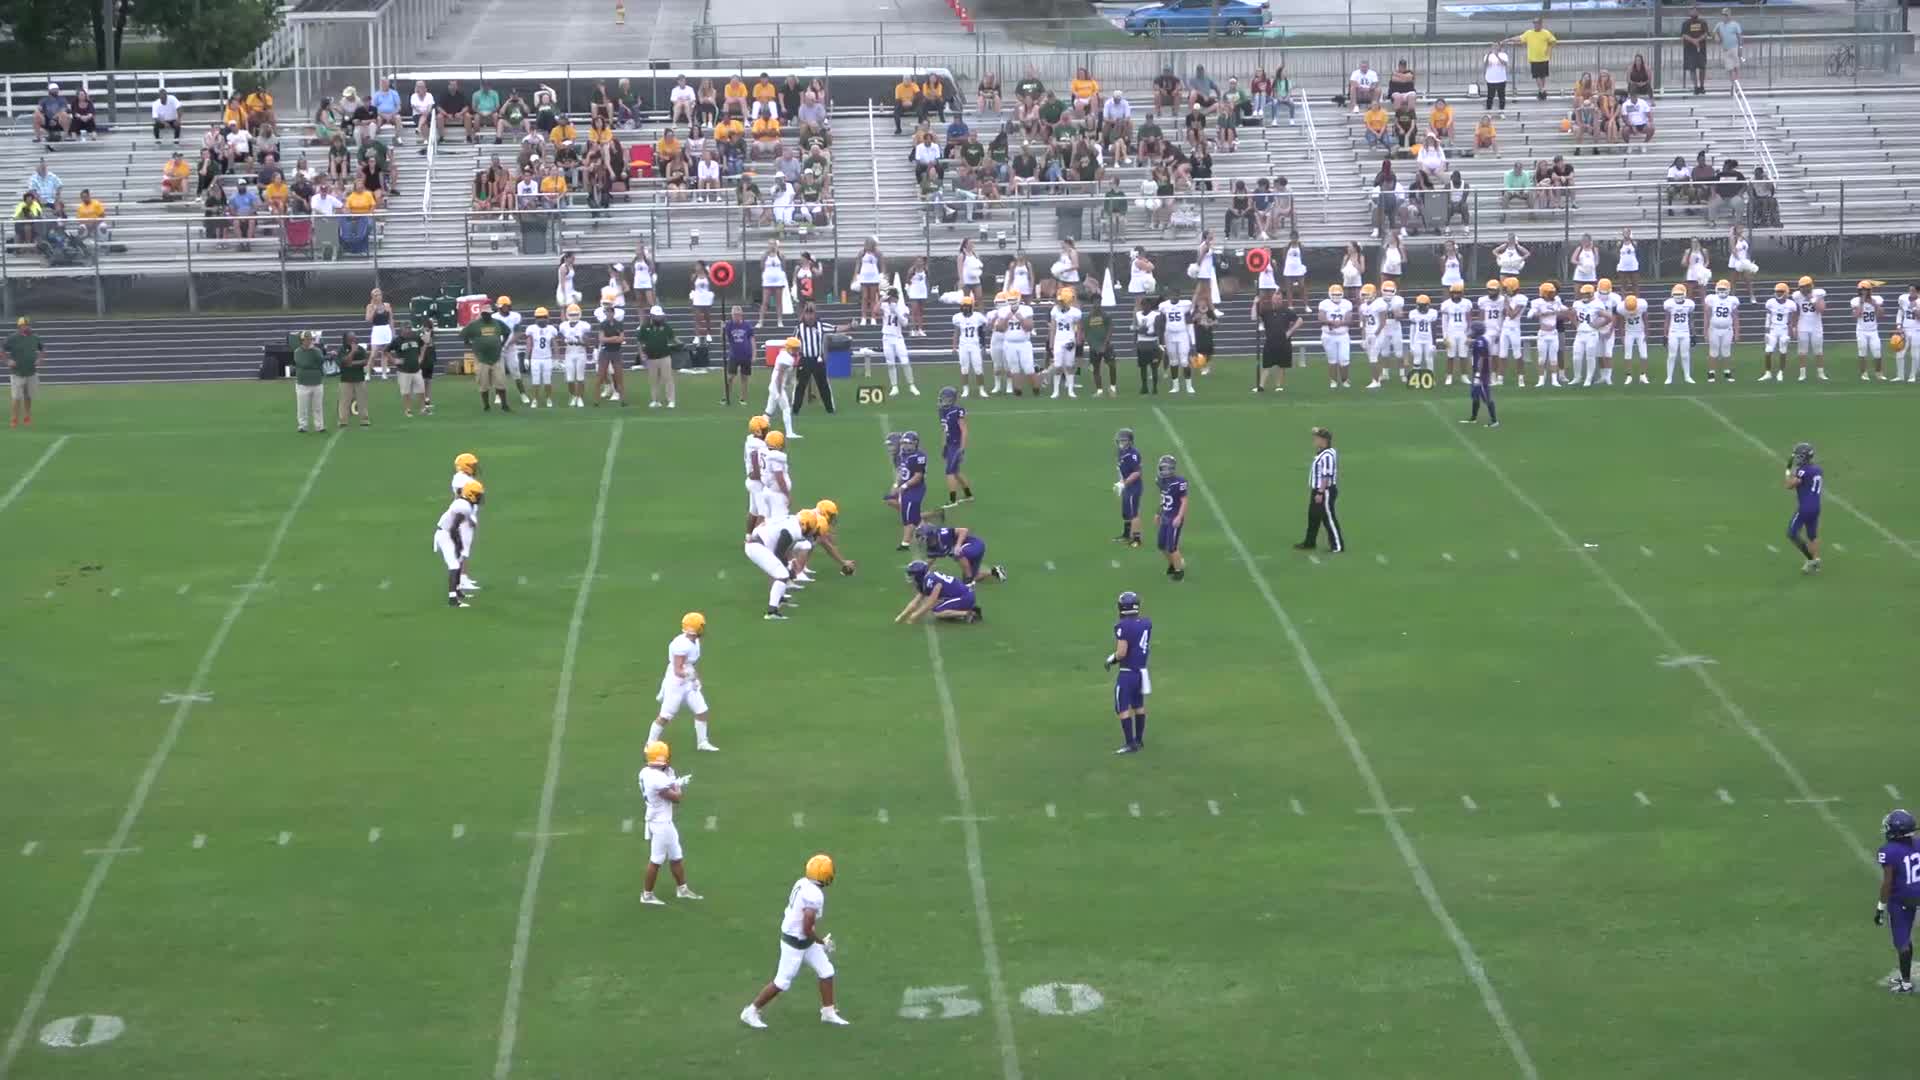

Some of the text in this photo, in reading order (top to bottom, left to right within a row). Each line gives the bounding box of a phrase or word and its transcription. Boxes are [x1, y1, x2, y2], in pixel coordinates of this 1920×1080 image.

[470, 303, 480, 314] G
[1488, 309, 1500, 320] 13
[1715, 306, 1730, 318] 52
[1168, 311, 1182, 322] 55
[1673, 312, 1687, 323] 25
[964, 326, 976, 338] 17
[539, 337, 547, 349] 8
[1409, 372, 1434, 389] 40
[859, 388, 884, 404] 50
[1138, 629, 1149, 654] 4
[1903, 851, 1920, 885] 12
